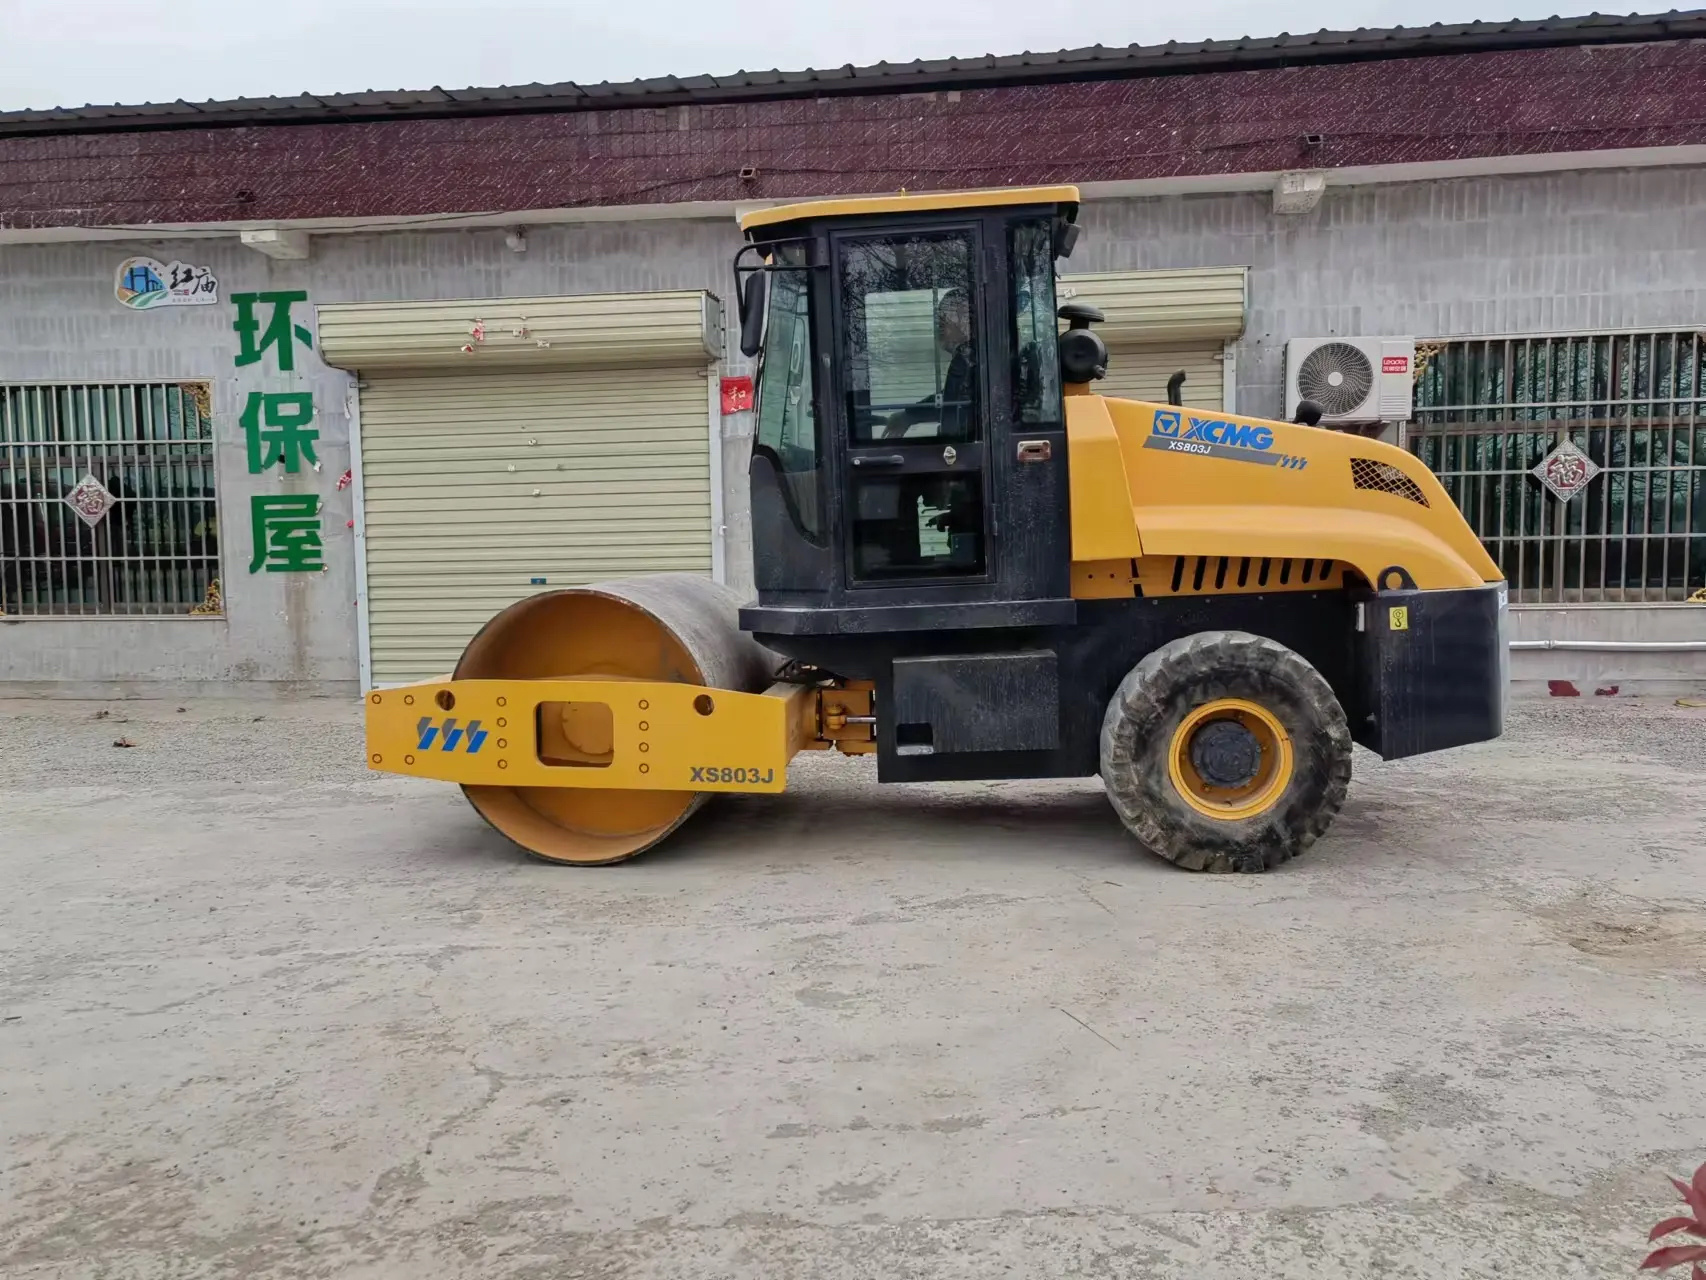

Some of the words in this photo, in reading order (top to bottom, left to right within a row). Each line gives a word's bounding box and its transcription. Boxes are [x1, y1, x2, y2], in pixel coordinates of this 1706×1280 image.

[230, 290, 325, 576] 环保屋
[1181, 417, 1274, 450] XCMG
[1168, 440, 1212, 454] XS803J
[690, 766, 774, 784] XS803J
